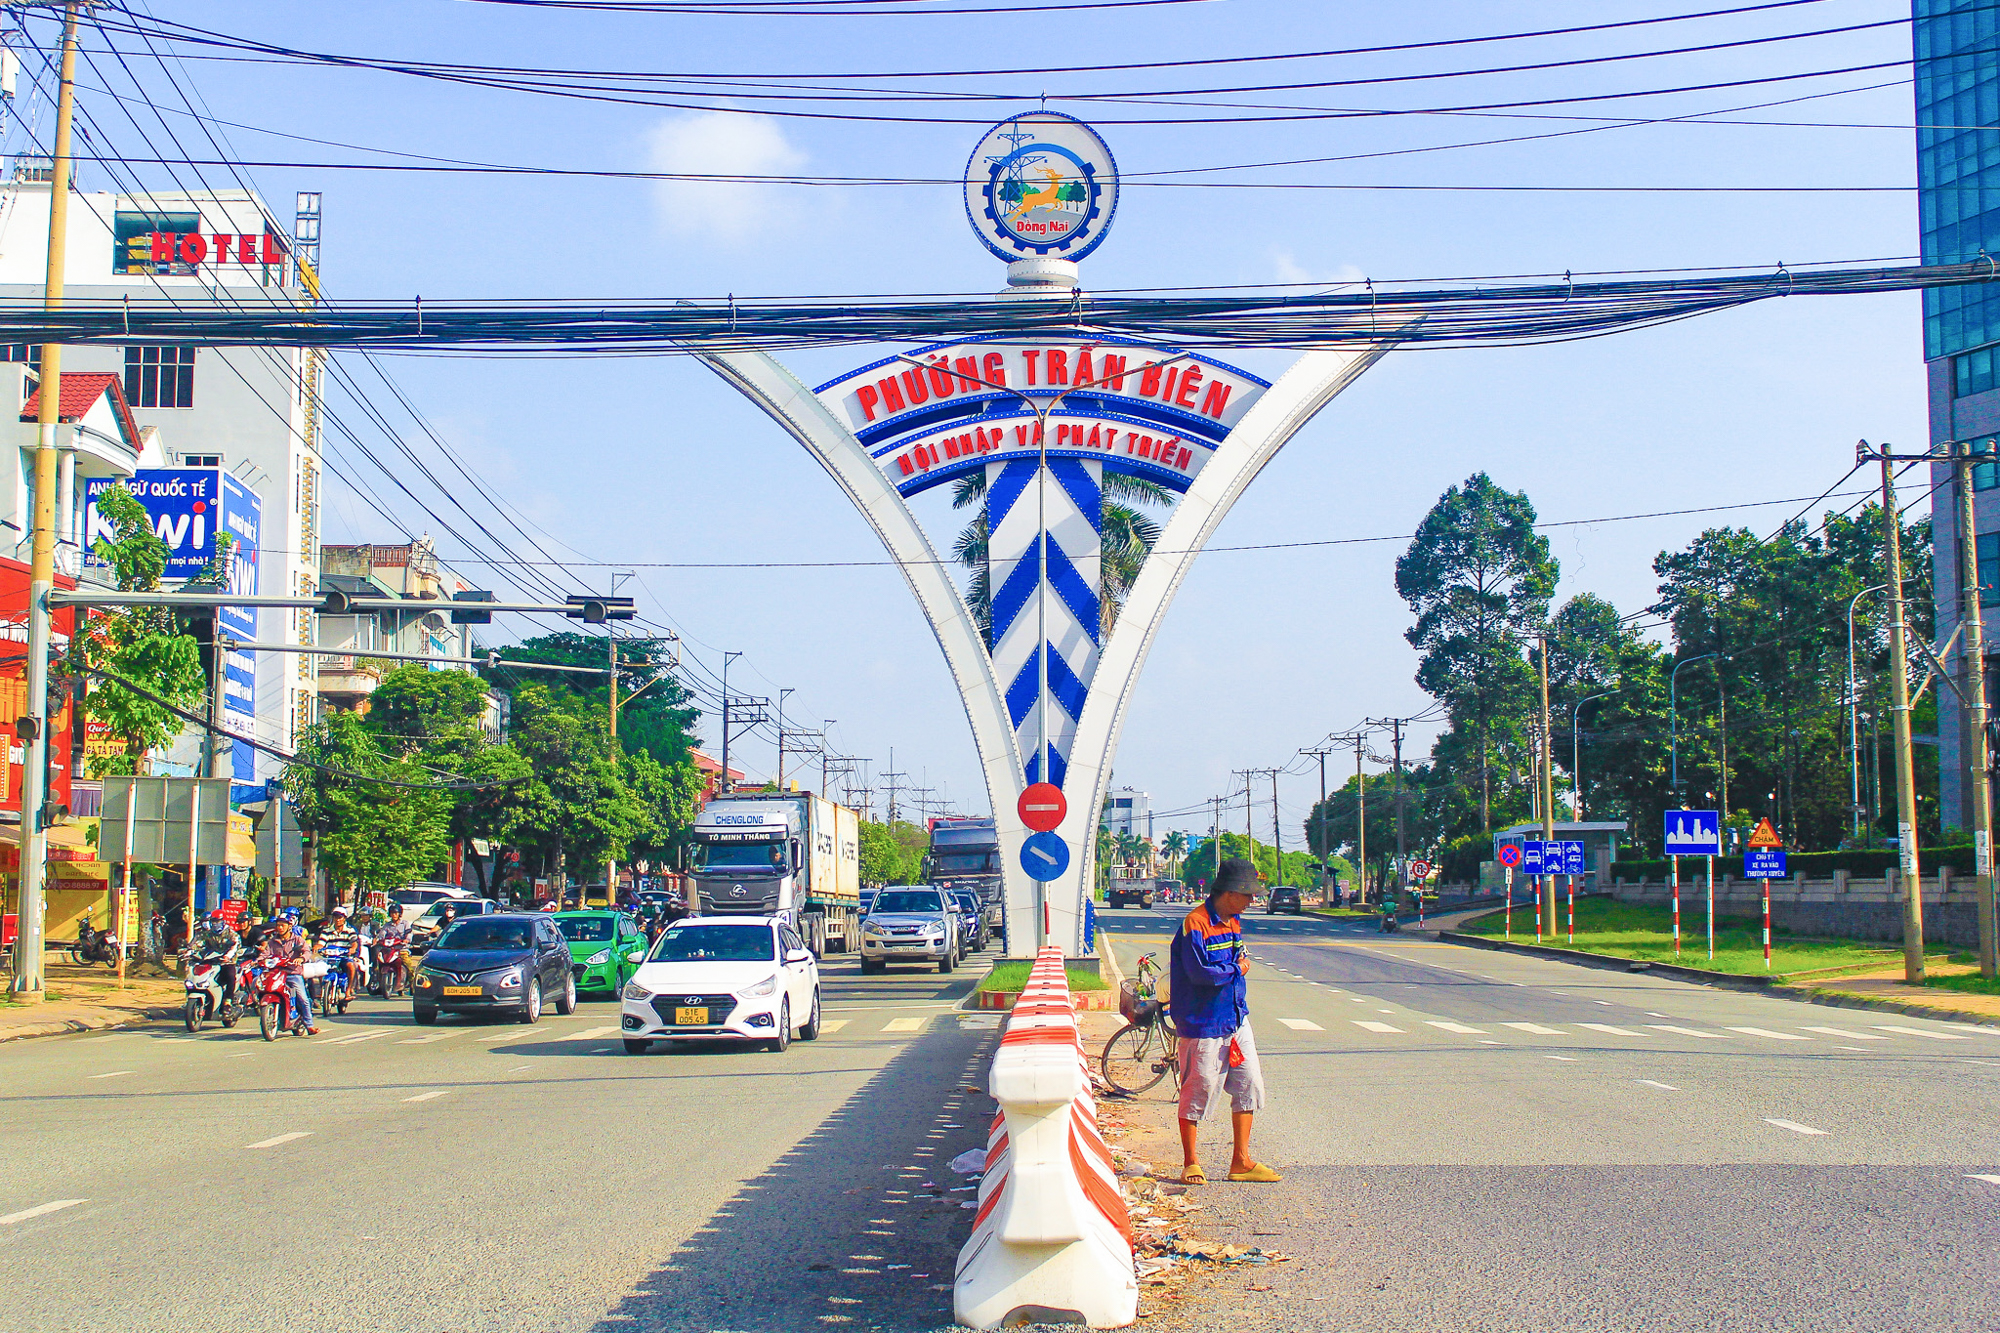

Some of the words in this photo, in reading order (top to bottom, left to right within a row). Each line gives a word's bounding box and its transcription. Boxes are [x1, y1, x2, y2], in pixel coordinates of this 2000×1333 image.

[1049, 221, 1069, 233] Nai
[152, 232, 280, 264] HOTEL
[856, 352, 1006, 421] PHƯỜNG
[1139, 361, 1232, 419] BIÊN
[897, 443, 939, 476] HỘI
[933, 426, 1003, 459] NHẬP
[1015, 420, 1043, 446] VÀ
[1057, 423, 1117, 449] PHÁT
[1128, 435, 1193, 470] TRIỂN
[150, 477, 187, 497] QUỐC
[191, 477, 208, 497] TẾ
[87, 501, 206, 550] Kwi
[171, 556, 186, 567] mọi
[715, 815, 764, 825] CHENGLONG
